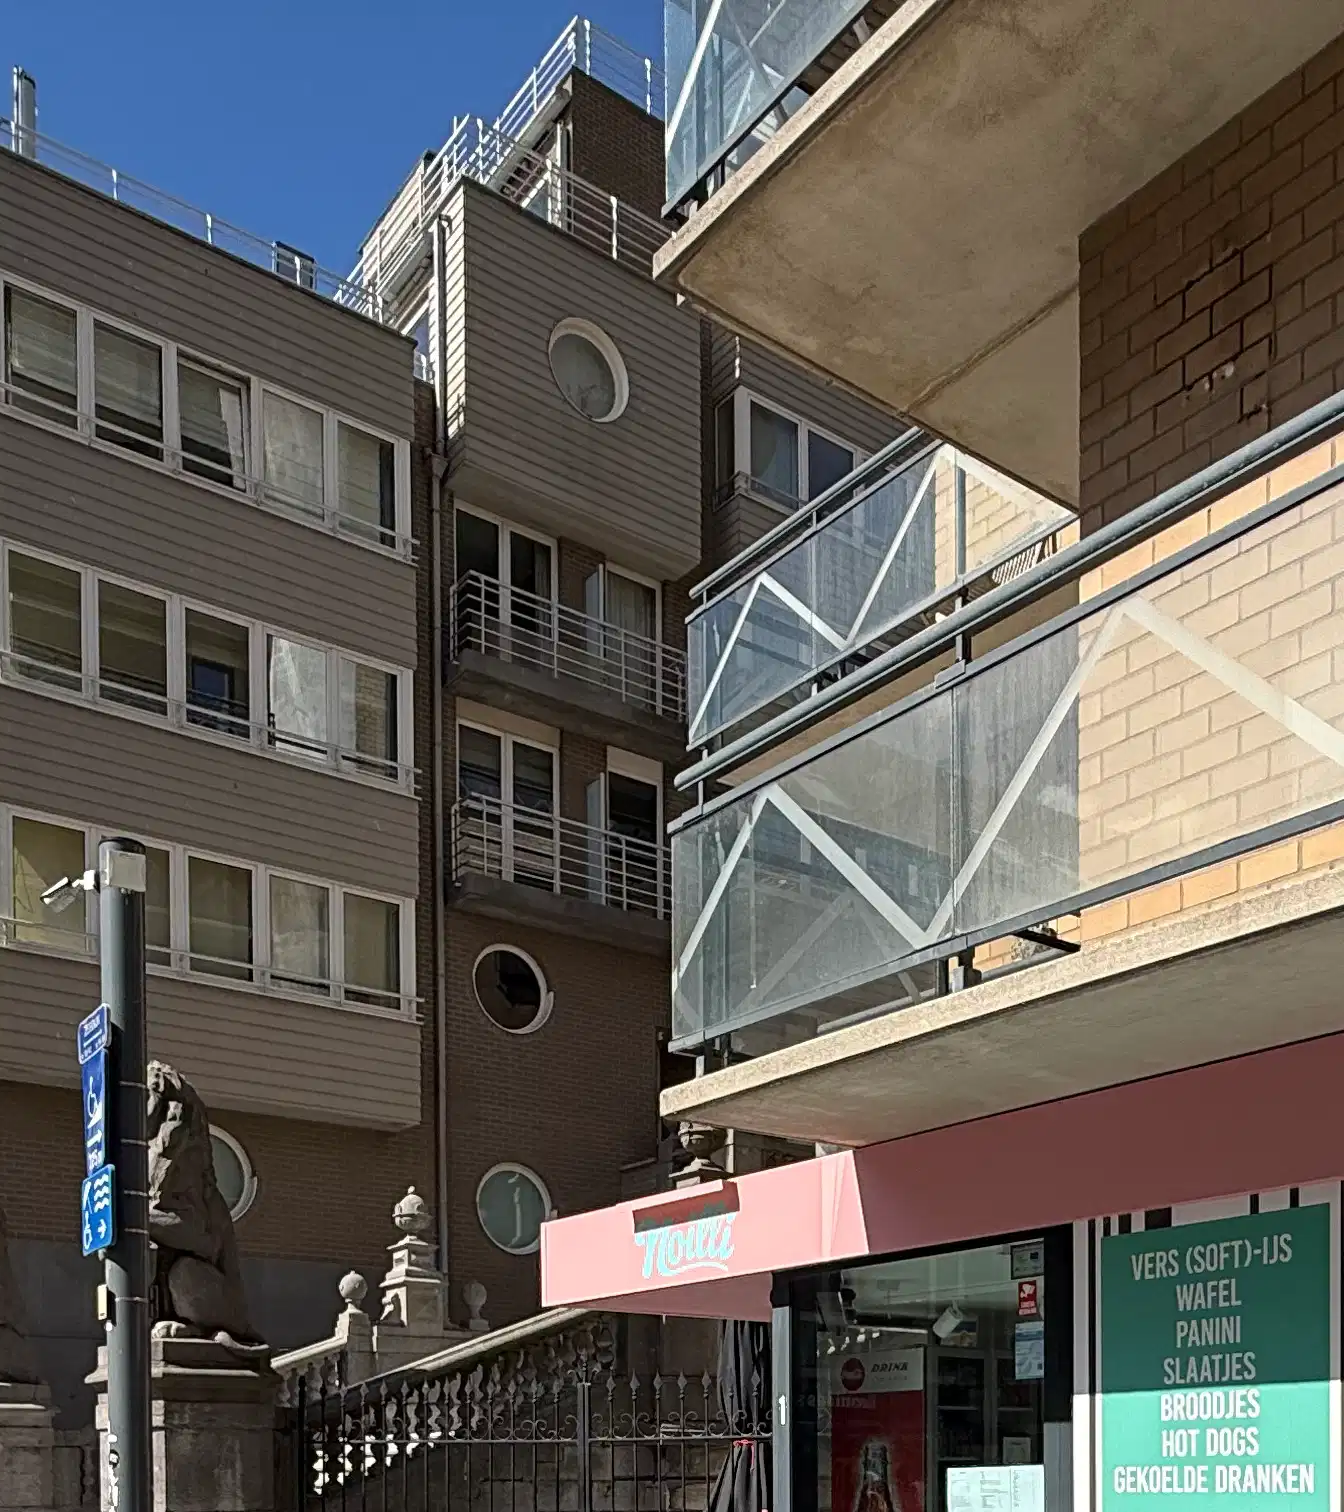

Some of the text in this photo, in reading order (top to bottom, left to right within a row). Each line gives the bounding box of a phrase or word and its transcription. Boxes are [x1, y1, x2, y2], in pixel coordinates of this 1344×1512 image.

[634, 1201, 736, 1279] Noilli
[1131, 1233, 1292, 1281] VERS (SOFT)-IJS
[1176, 1278, 1242, 1312] WAFEL
[1176, 1315, 1241, 1348] PANINI
[871, 1361, 909, 1373] DRINK
[1163, 1351, 1257, 1385] SLAATJES
[1160, 1388, 1261, 1422] BROODJES
[1161, 1426, 1260, 1458] HOT DOGS
[1113, 1463, 1315, 1495] GEKOELDE DRANKEN
